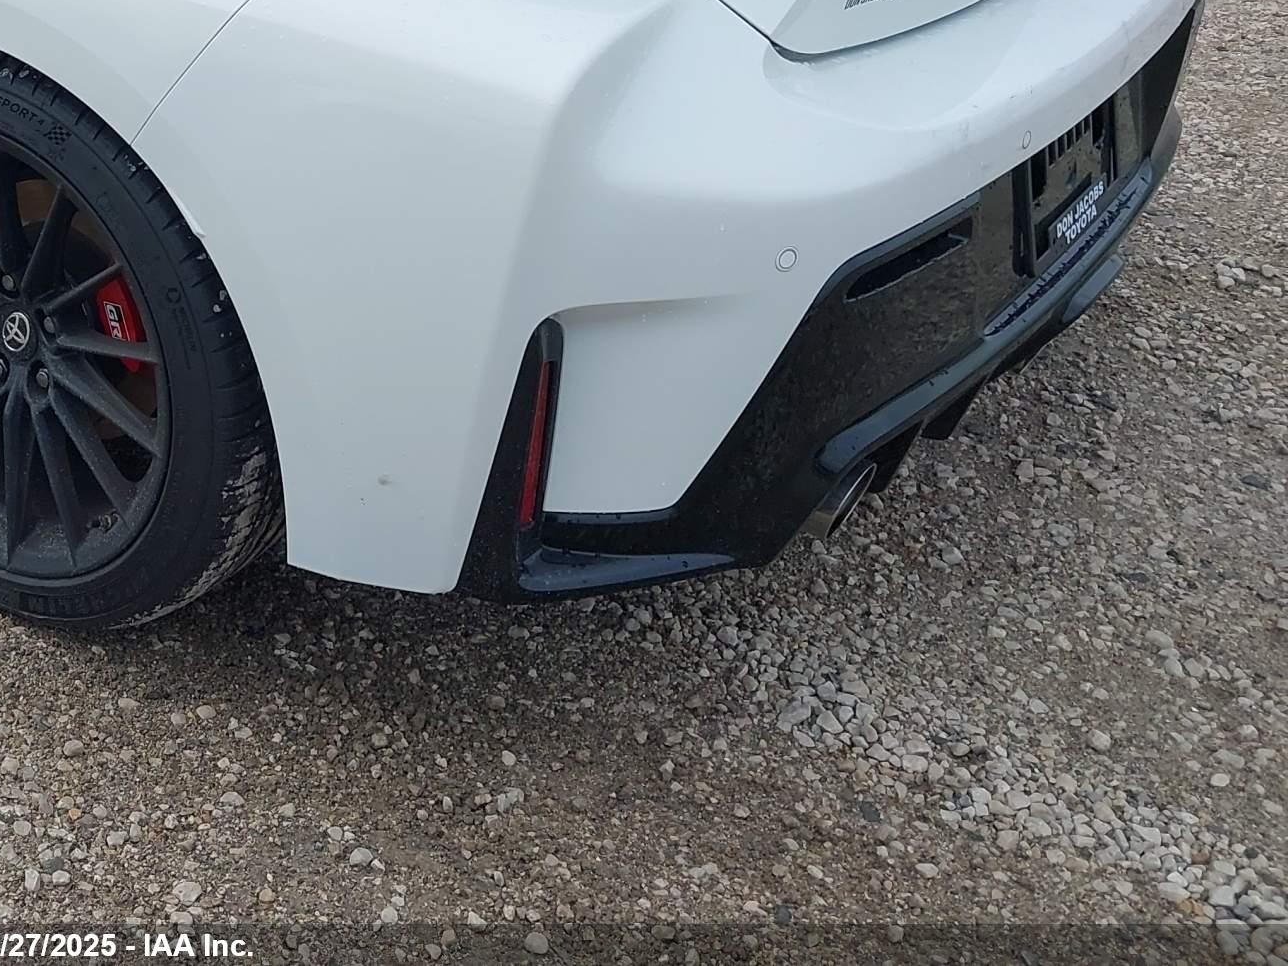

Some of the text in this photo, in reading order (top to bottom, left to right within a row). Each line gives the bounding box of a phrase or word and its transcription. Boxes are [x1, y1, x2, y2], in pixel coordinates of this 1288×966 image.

[1056, 180, 1105, 238] DON JACOBS
[1064, 206, 1098, 245] TOYOTA
